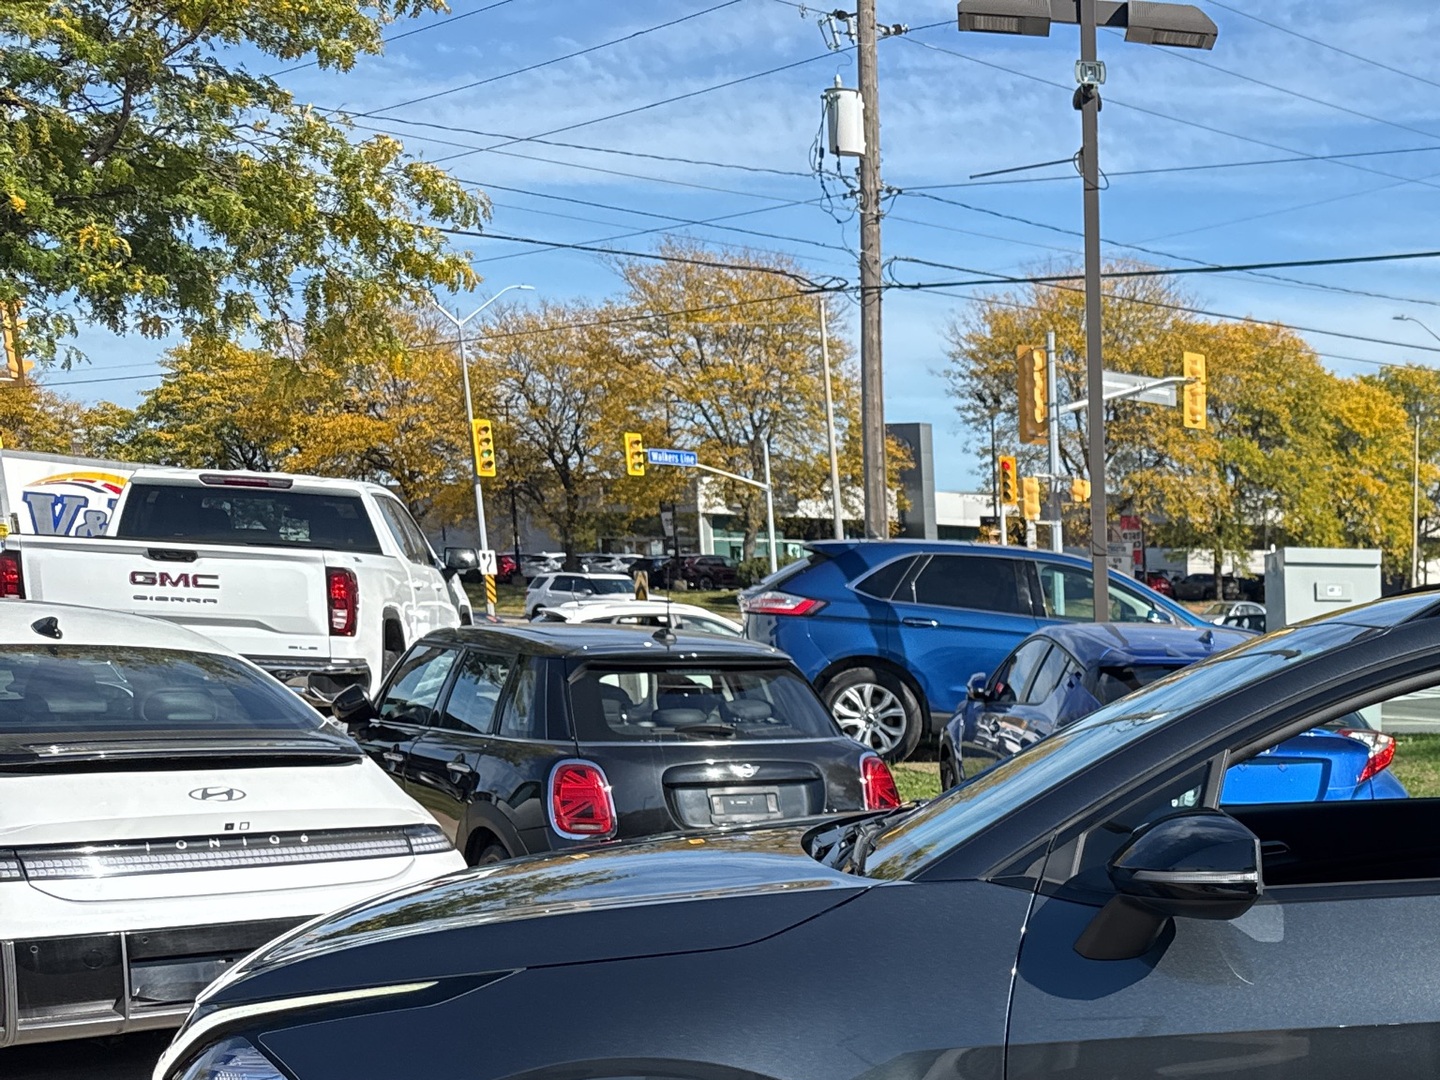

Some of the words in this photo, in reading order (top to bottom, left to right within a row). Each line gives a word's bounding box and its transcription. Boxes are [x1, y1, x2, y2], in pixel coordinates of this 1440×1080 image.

[651, 451, 679, 463] Walkers
[680, 453, 695, 465] Line
[129, 571, 220, 589] GMC
[133, 595, 218, 604] SIERRA
